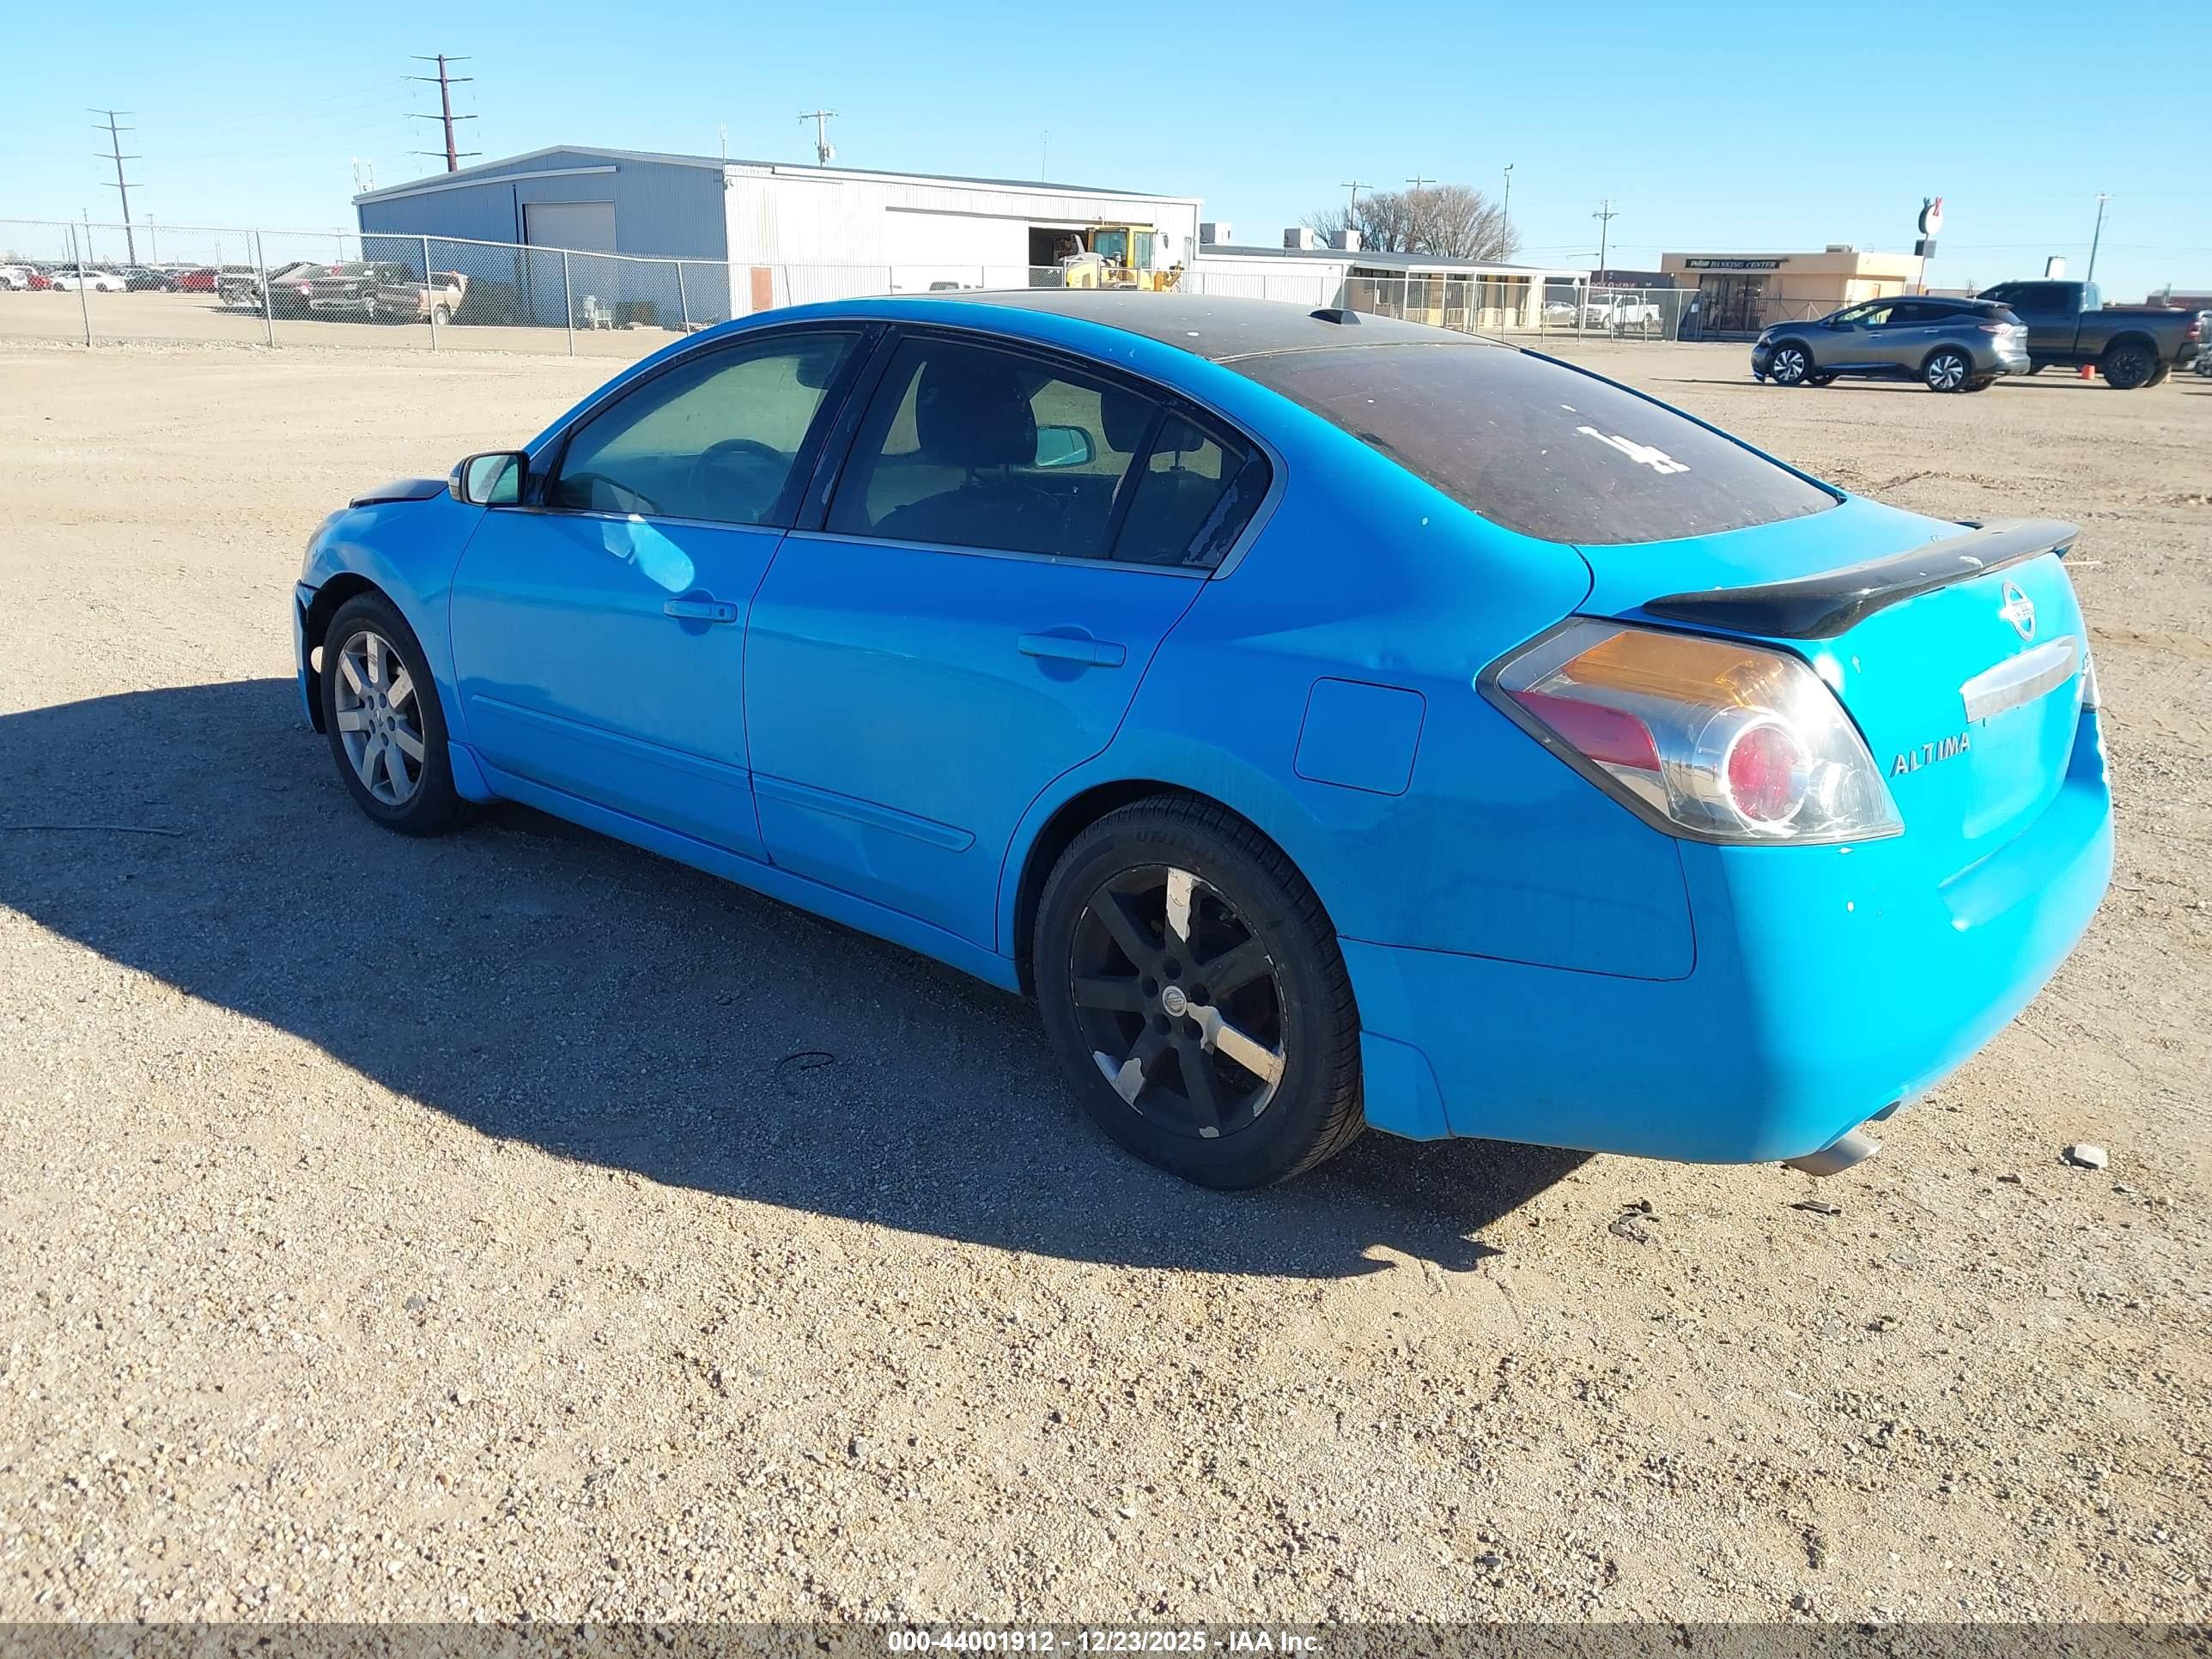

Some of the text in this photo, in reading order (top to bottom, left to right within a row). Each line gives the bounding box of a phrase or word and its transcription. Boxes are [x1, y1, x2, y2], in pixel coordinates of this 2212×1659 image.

[1710, 260, 1744, 269] BANKING
[1745, 260, 1777, 269] CENTER
[1889, 731, 1972, 778] ALTIMA
